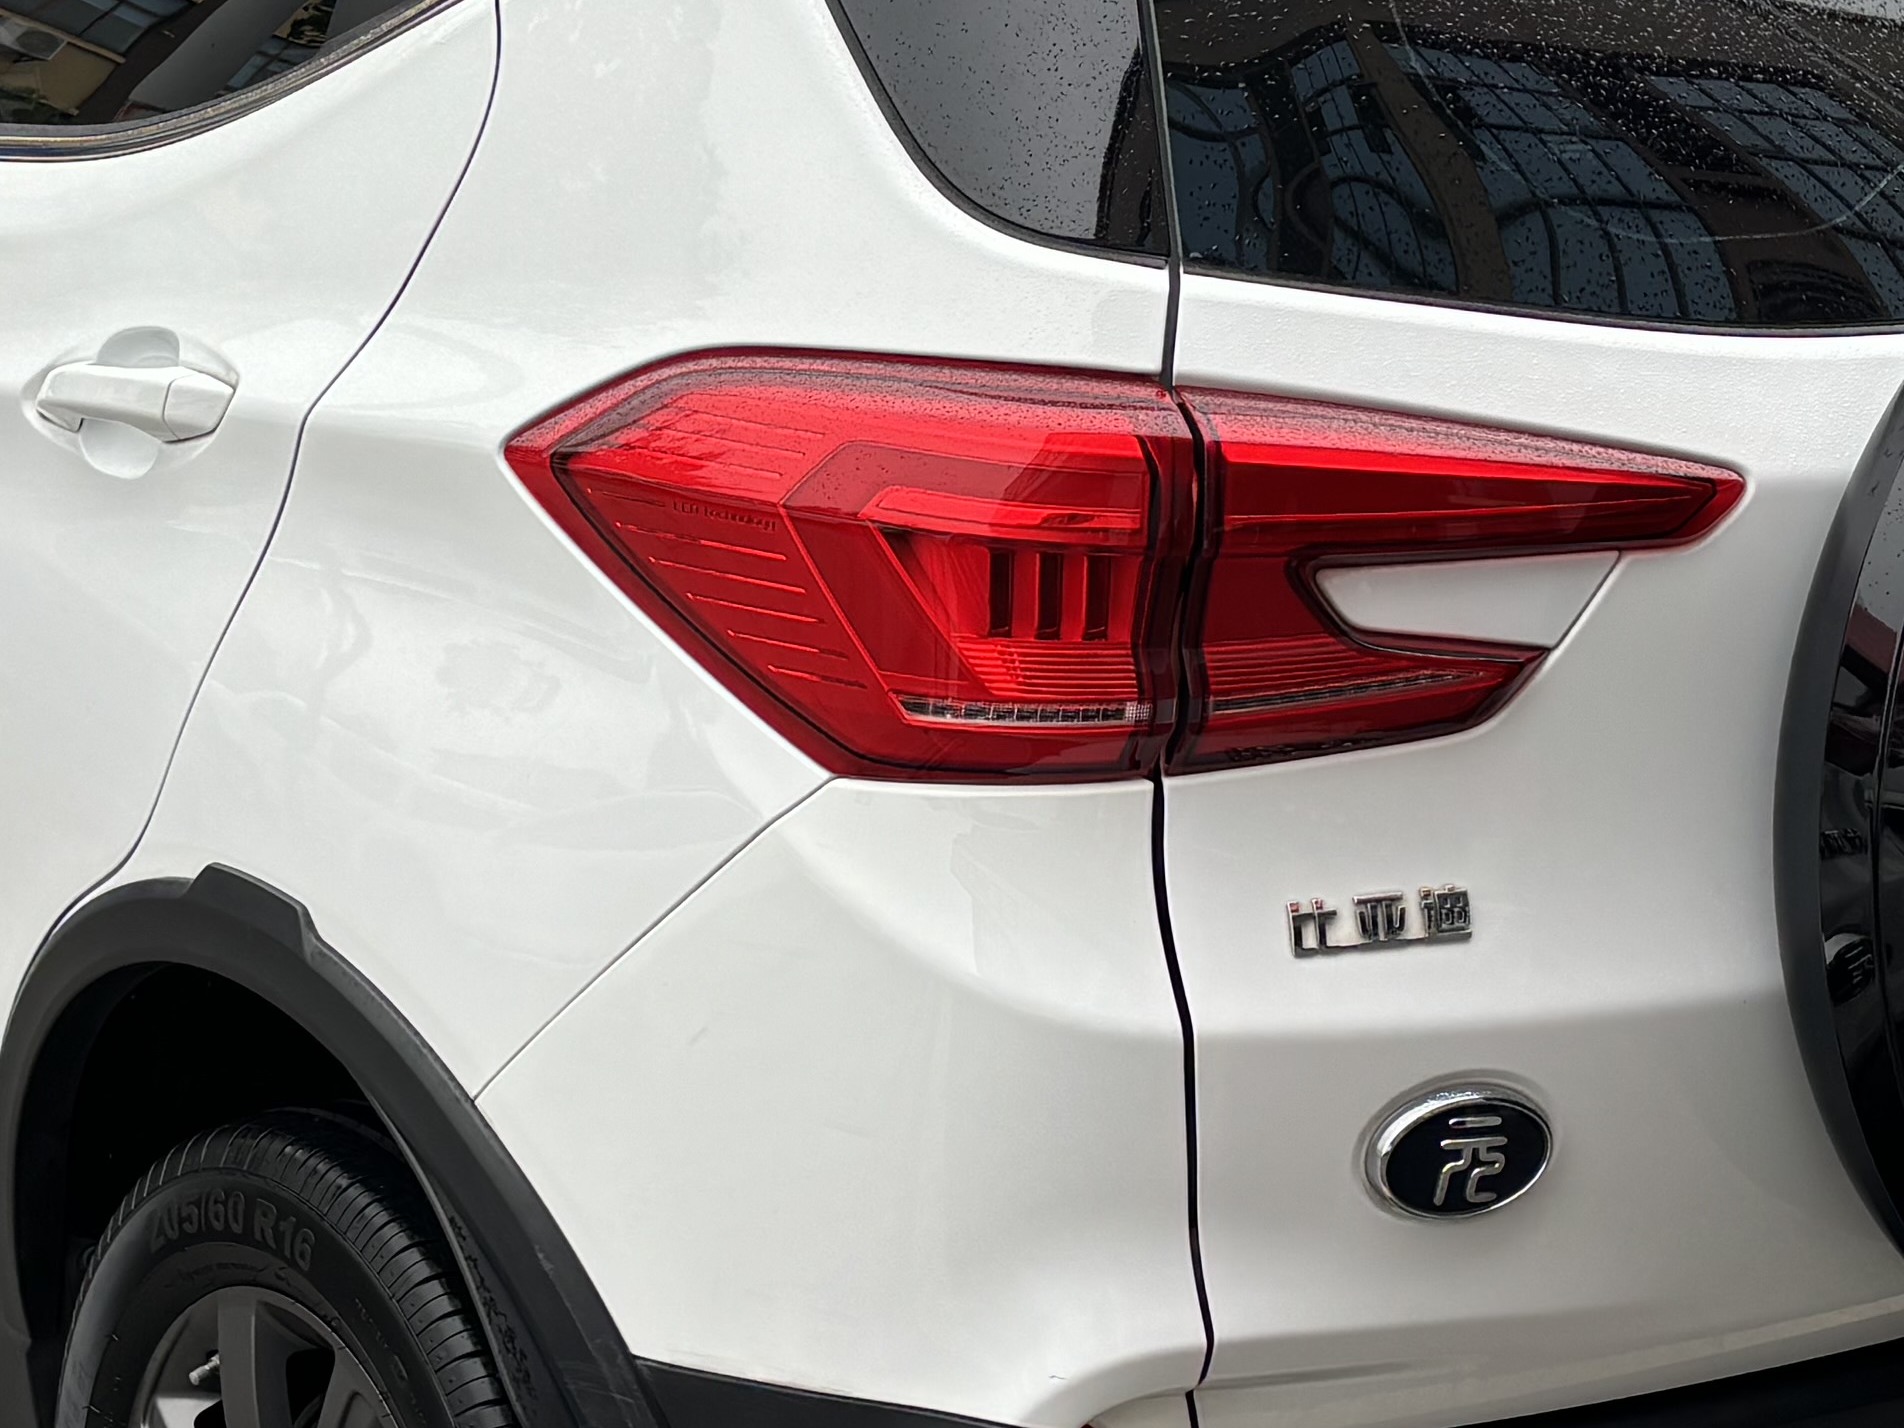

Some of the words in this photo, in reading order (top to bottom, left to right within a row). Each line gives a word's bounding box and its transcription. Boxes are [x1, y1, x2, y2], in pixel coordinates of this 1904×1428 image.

[1286, 884, 1473, 958] 比亚迪
[1433, 1116, 1508, 1207] 元
[253, 1198, 317, 1272] R16
